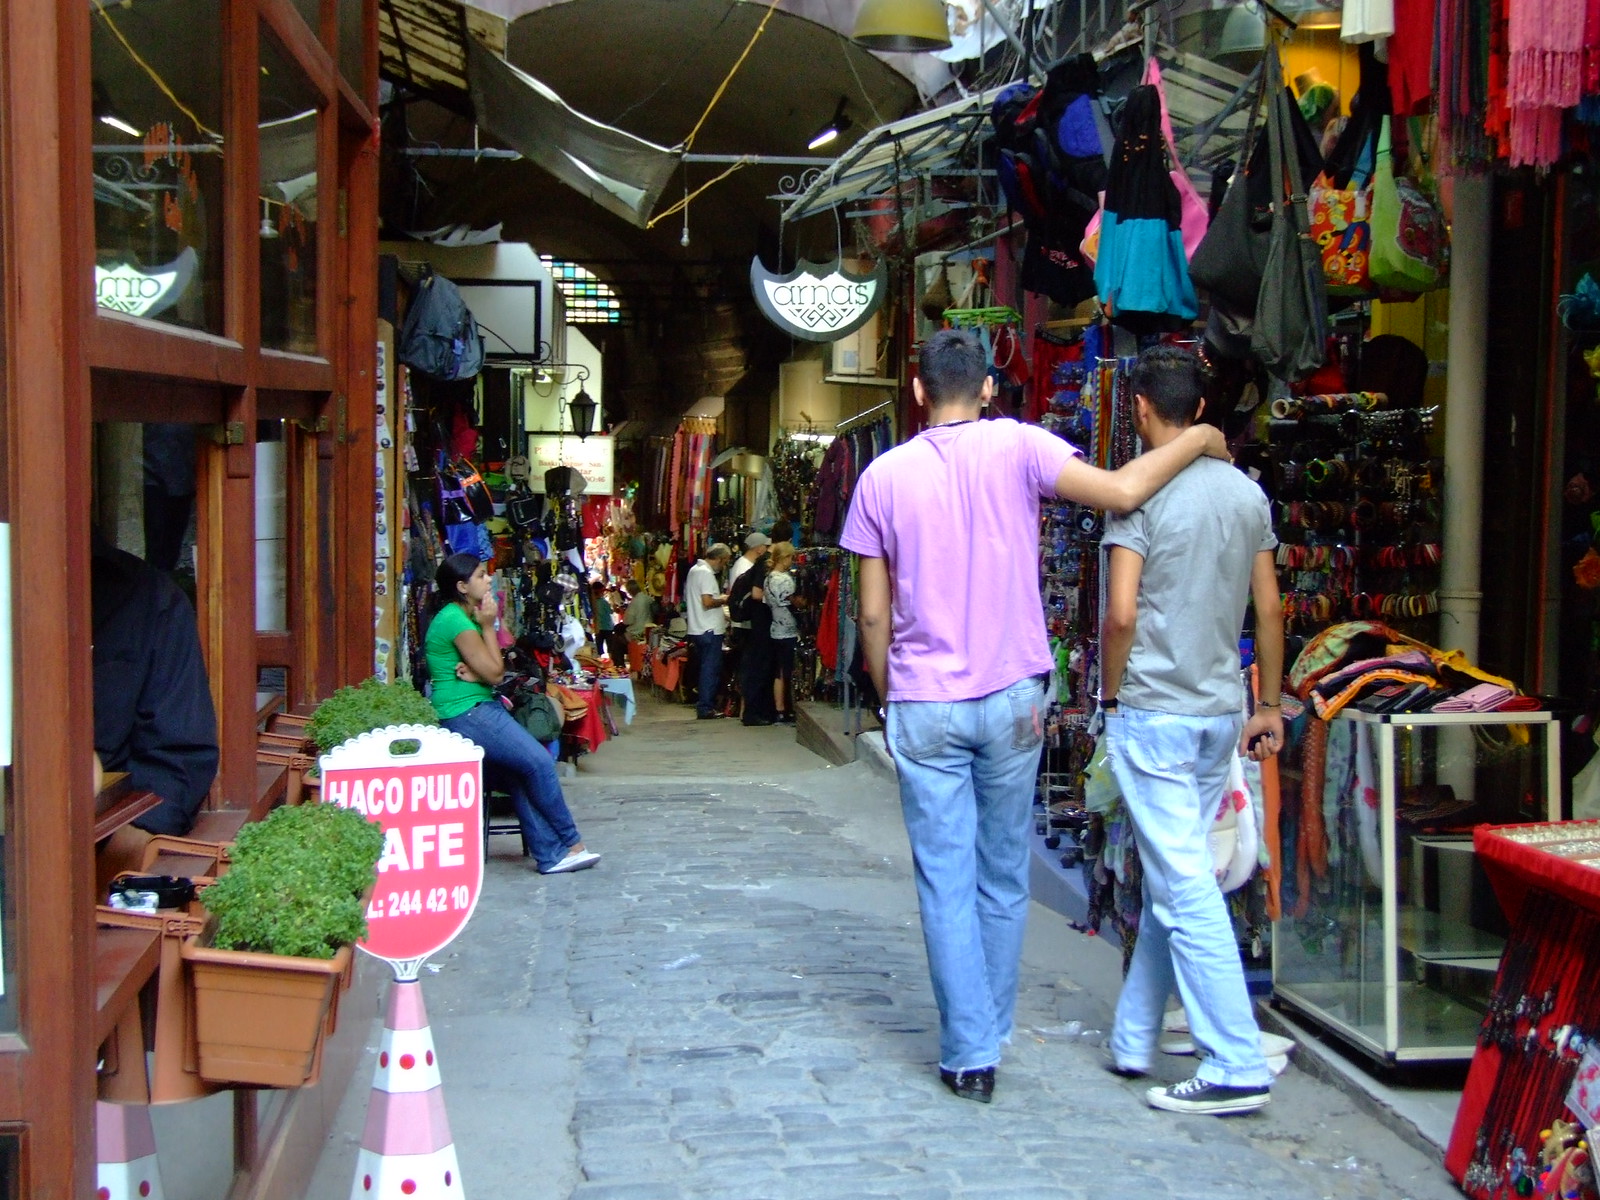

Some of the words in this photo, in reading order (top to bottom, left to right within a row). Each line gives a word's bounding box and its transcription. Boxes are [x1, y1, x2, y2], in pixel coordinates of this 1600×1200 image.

[774, 285, 869, 305] arnas
[329, 777, 405, 816] HACO
[411, 772, 476, 812] PULO
[378, 822, 465, 873] AFE
[388, 890, 422, 917] 244
[426, 887, 447, 912] 42
[451, 885, 469, 910] 10
